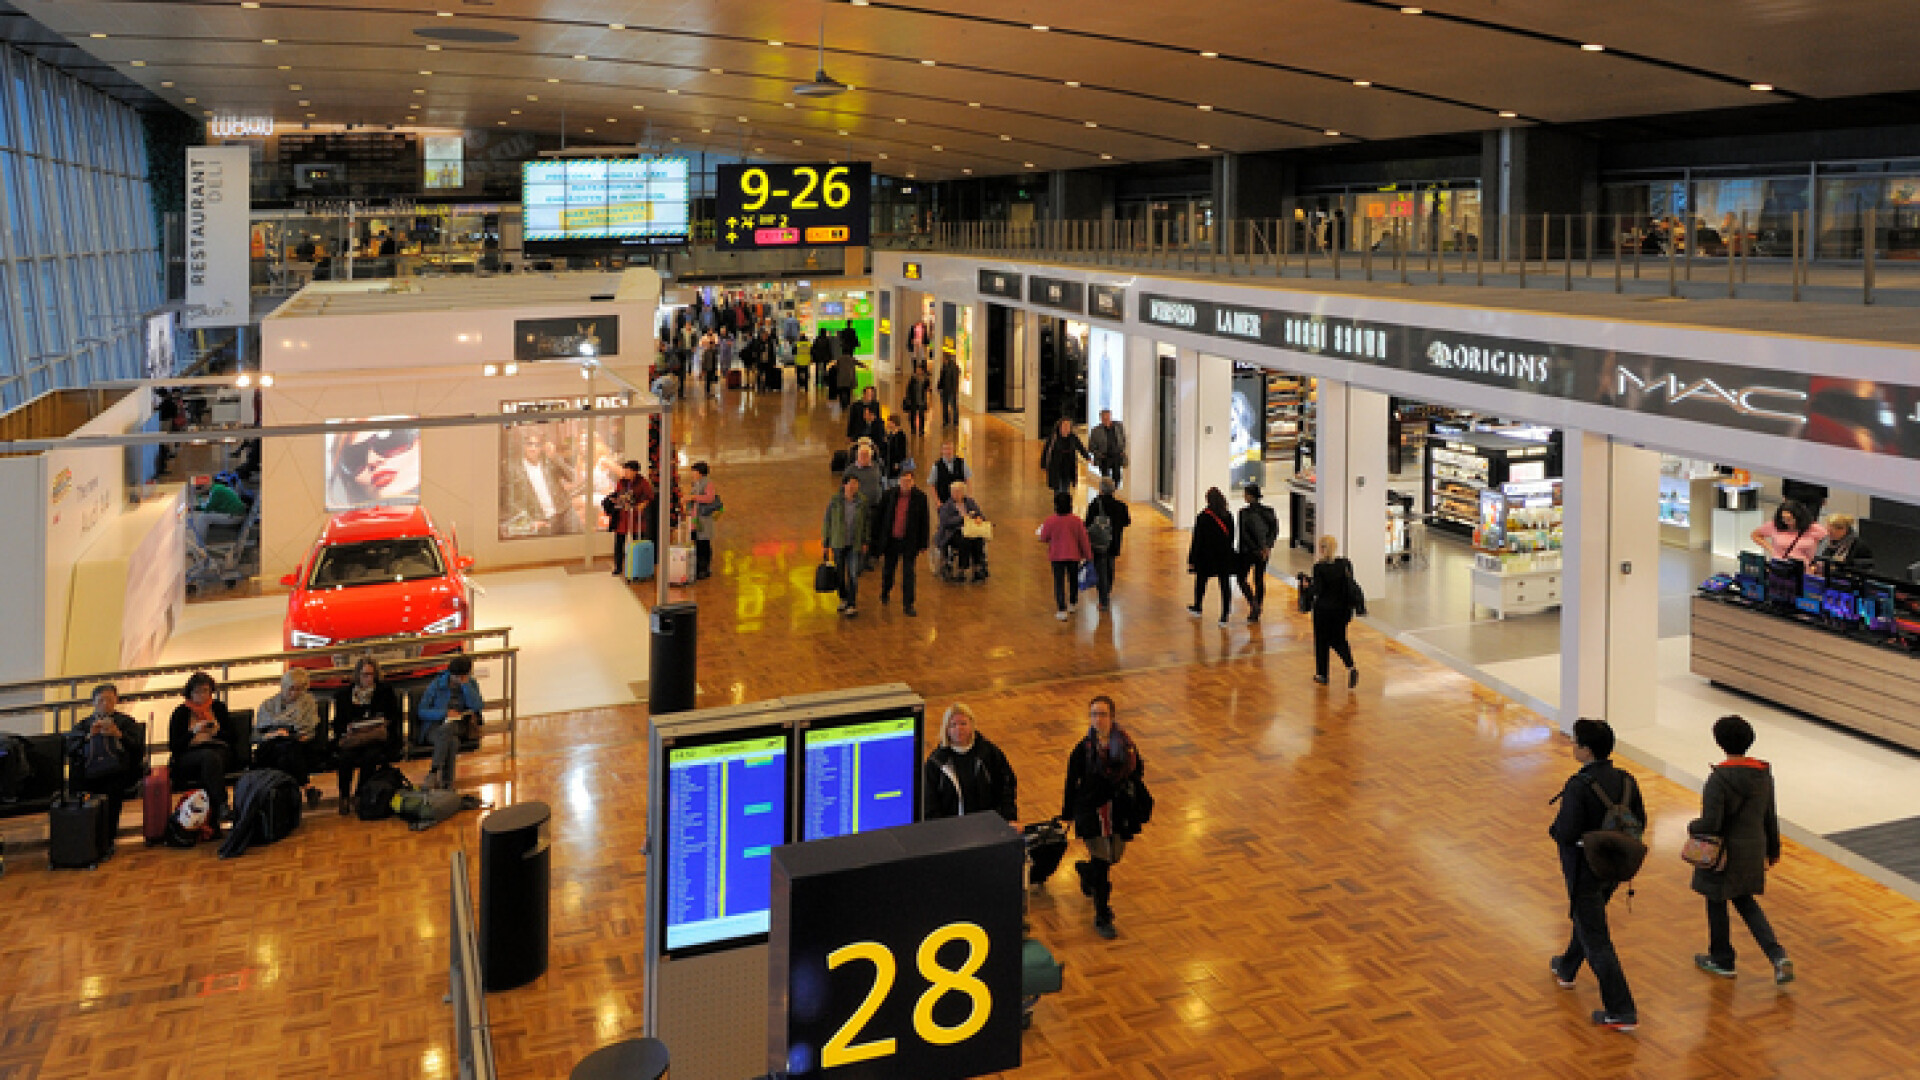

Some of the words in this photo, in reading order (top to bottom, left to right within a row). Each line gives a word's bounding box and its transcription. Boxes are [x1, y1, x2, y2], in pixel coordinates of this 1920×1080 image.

[206, 159, 223, 204] DELI
[740, 167, 850, 210] 9-26
[191, 158, 206, 287] RESTAURANT
[1453, 343, 1548, 382] ORIGINS
[821, 921, 993, 1068] 28
